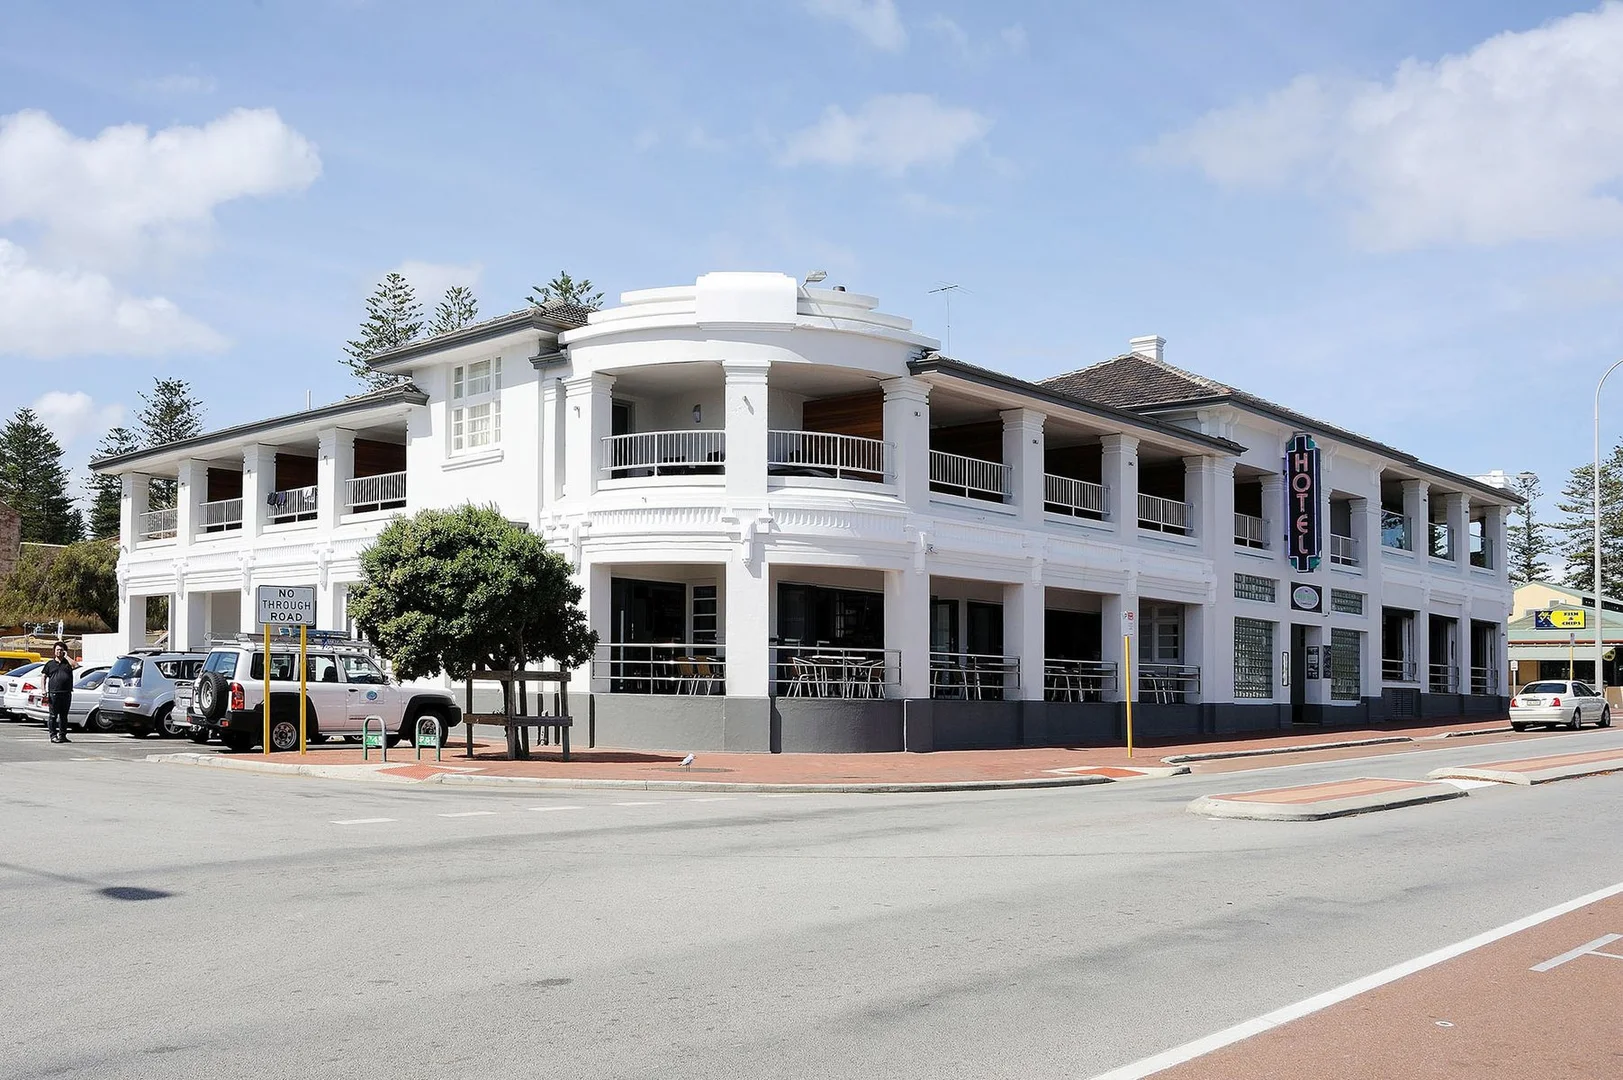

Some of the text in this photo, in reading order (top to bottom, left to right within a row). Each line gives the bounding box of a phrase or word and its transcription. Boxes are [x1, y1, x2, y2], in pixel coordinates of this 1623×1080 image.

[1292, 453, 1311, 554] HOTEL
[278, 589, 295, 598] NO
[262, 600, 311, 610] THROUGH
[270, 612, 303, 621] ROAD
